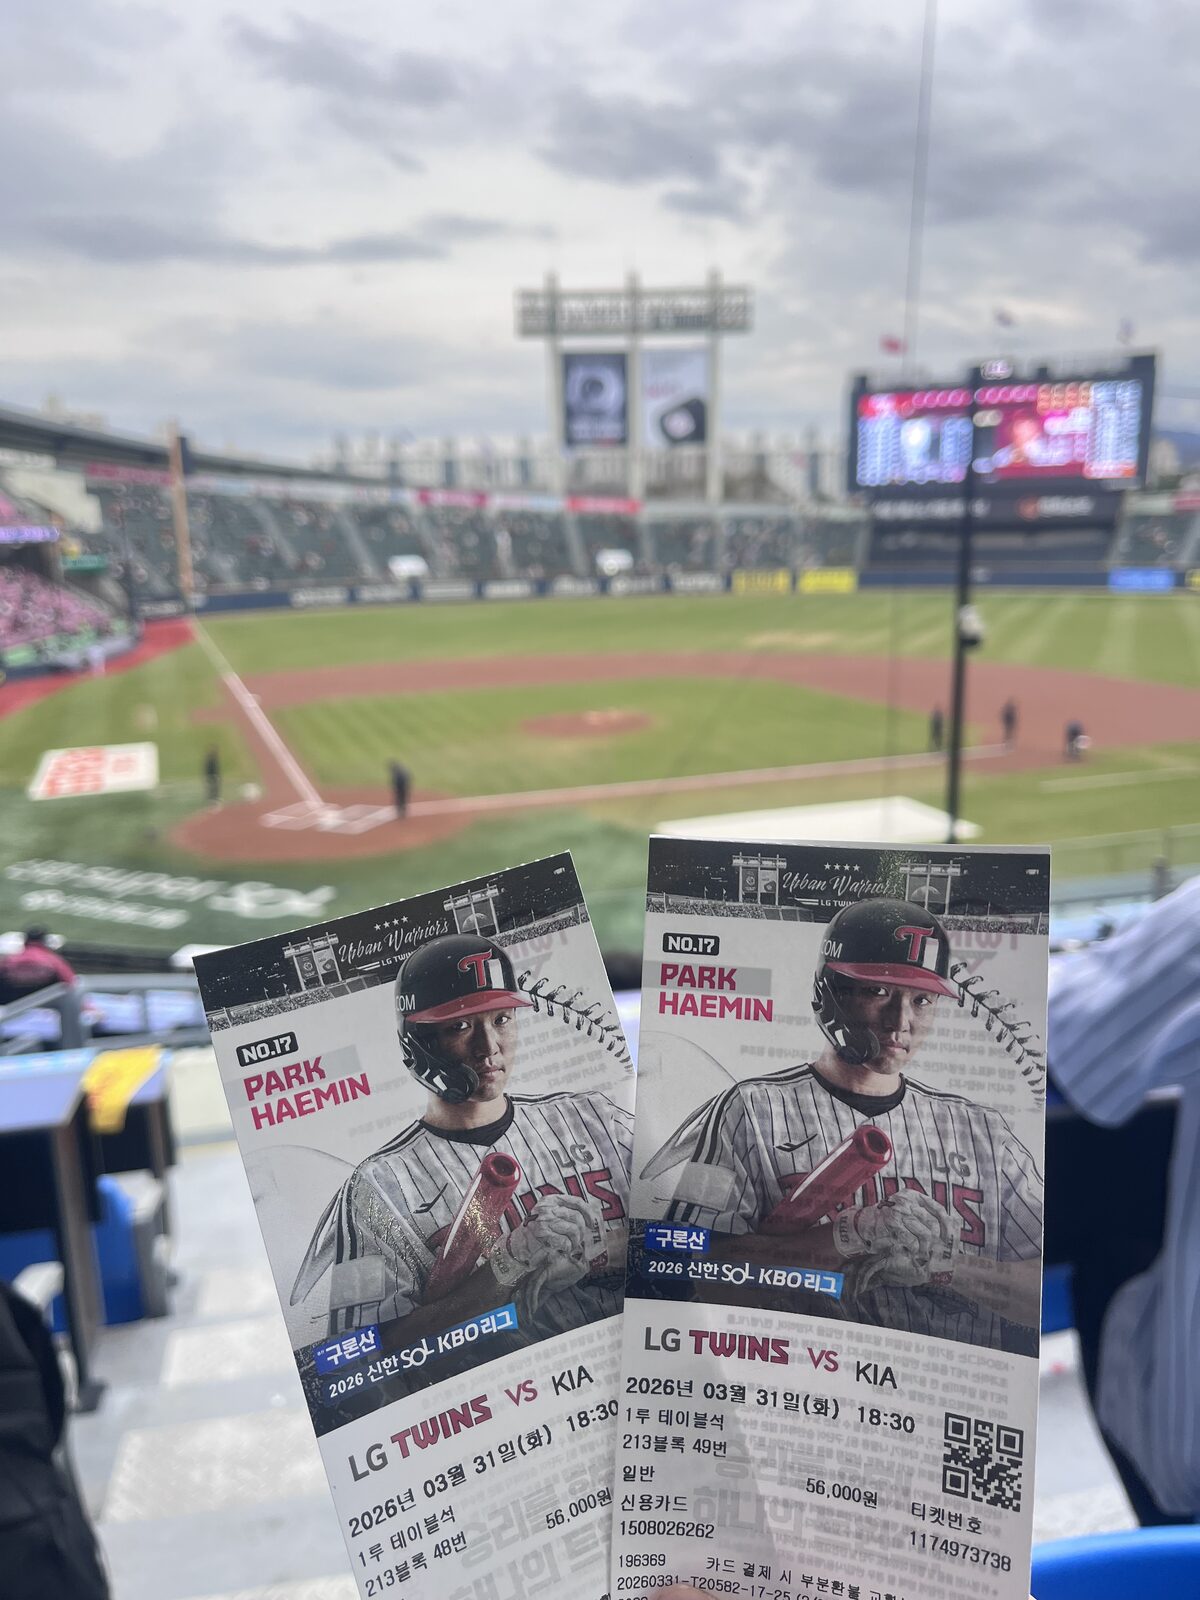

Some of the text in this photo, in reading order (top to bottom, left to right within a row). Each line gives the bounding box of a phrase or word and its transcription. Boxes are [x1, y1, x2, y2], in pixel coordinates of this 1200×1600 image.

[783, 872, 899, 897] Urban Warriors
[820, 899, 831, 907] LG
[339, 920, 449, 965] Urban Warriors
[668, 935, 715, 953] NO.17
[381, 957, 393, 967] LG
[660, 963, 737, 991] PARK
[659, 991, 773, 1022] HAEMIN
[241, 1036, 292, 1063] NO.17
[243, 1056, 325, 1101] PARK
[251, 1071, 371, 1130] HAEMIN
[551, 1145, 595, 1168] LG
[930, 1148, 971, 1177] LG
[656, 1230, 705, 1251] 구론산
[648, 1260, 683, 1276] 2026
[687, 1262, 719, 1280] 신한
[758, 1268, 802, 1289] KBO
[804, 1272, 837, 1295] 리그
[325, 1330, 376, 1366] 구론산
[328, 1373, 364, 1398] 2026
[366, 1356, 399, 1383] 신한
[438, 1324, 478, 1354] KBO
[480, 1309, 514, 1334] 리그
[644, 1326, 898, 1390] LG TWINS VS KIA
[625, 1376, 916, 1434] 2026년 03월 31일(화) 18:30
[625, 1407, 724, 1432] 1루 테이블석
[348, 1365, 594, 1482] LG TWINS VS KIA
[622, 1433, 727, 1459] 213블록 49번
[348, 1399, 619, 1538] 2026년 03월 31일(화) 18:30
[622, 1464, 656, 1483] 일반
[545, 1486, 613, 1530] 56,000원
[620, 1493, 688, 1512] 신용카드
[805, 1477, 878, 1510] 56,000원
[620, 1520, 715, 1539] 1508026262
[911, 1501, 982, 1535] 티켓번호
[358, 1505, 456, 1567] 1루 테이블석
[910, 1530, 1012, 1572] 1174973738
[365, 1530, 468, 1598] 213블록 48번
[619, 1553, 666, 1568] 196369
[705, 1556, 736, 1573] 카드
[742, 1562, 772, 1581] 결제
[779, 1569, 792, 1585] 시
[800, 1573, 861, 1600] 부분환불
